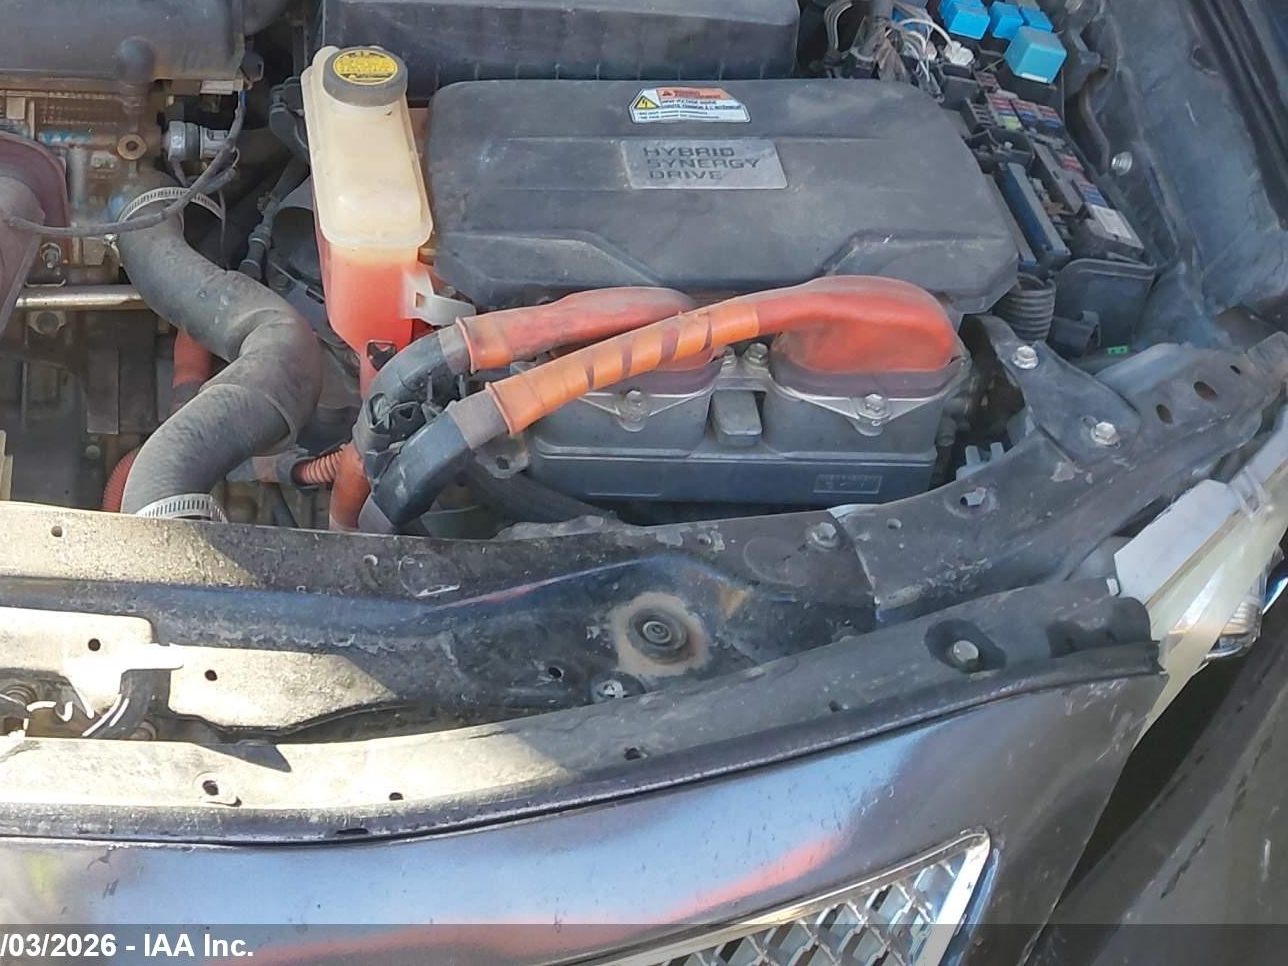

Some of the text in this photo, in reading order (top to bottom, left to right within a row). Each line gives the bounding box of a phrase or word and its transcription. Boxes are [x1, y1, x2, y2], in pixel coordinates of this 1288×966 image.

[643, 147, 735, 157] HYBRID
[647, 158, 760, 168] SYNERGY
[650, 170, 723, 180] DRIVE
